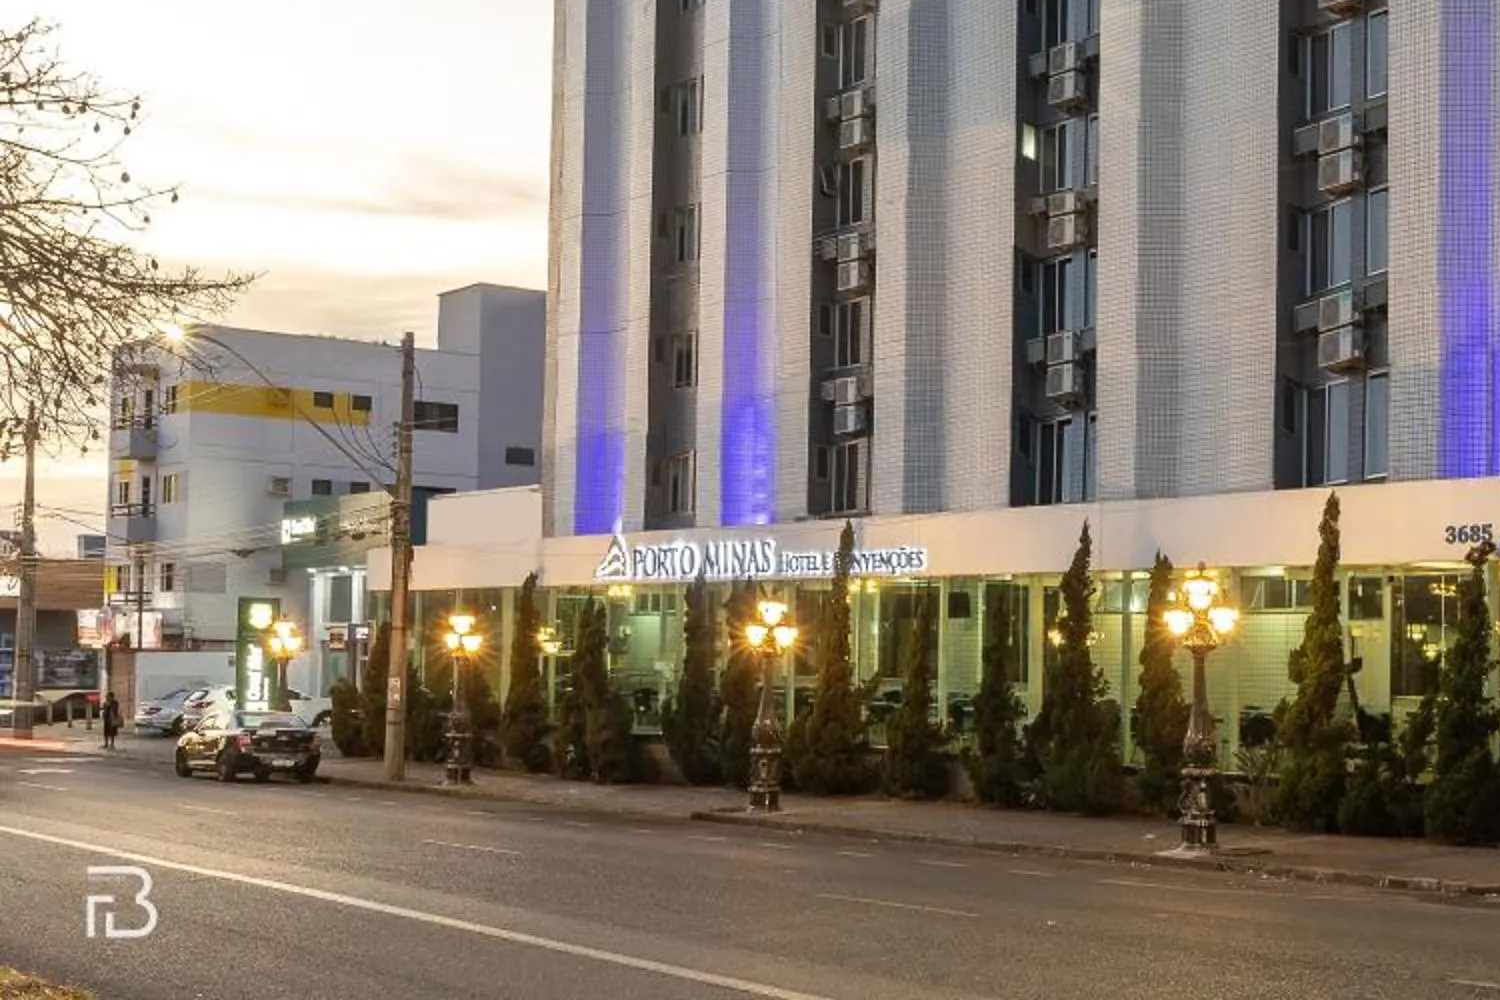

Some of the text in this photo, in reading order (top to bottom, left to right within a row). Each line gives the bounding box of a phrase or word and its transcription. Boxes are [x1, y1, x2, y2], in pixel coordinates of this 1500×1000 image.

[1445, 523, 1493, 544] 3685
[632, 544, 696, 577] PORTO
[702, 540, 771, 576] MINAS
[782, 552, 820, 573] HOTEL
